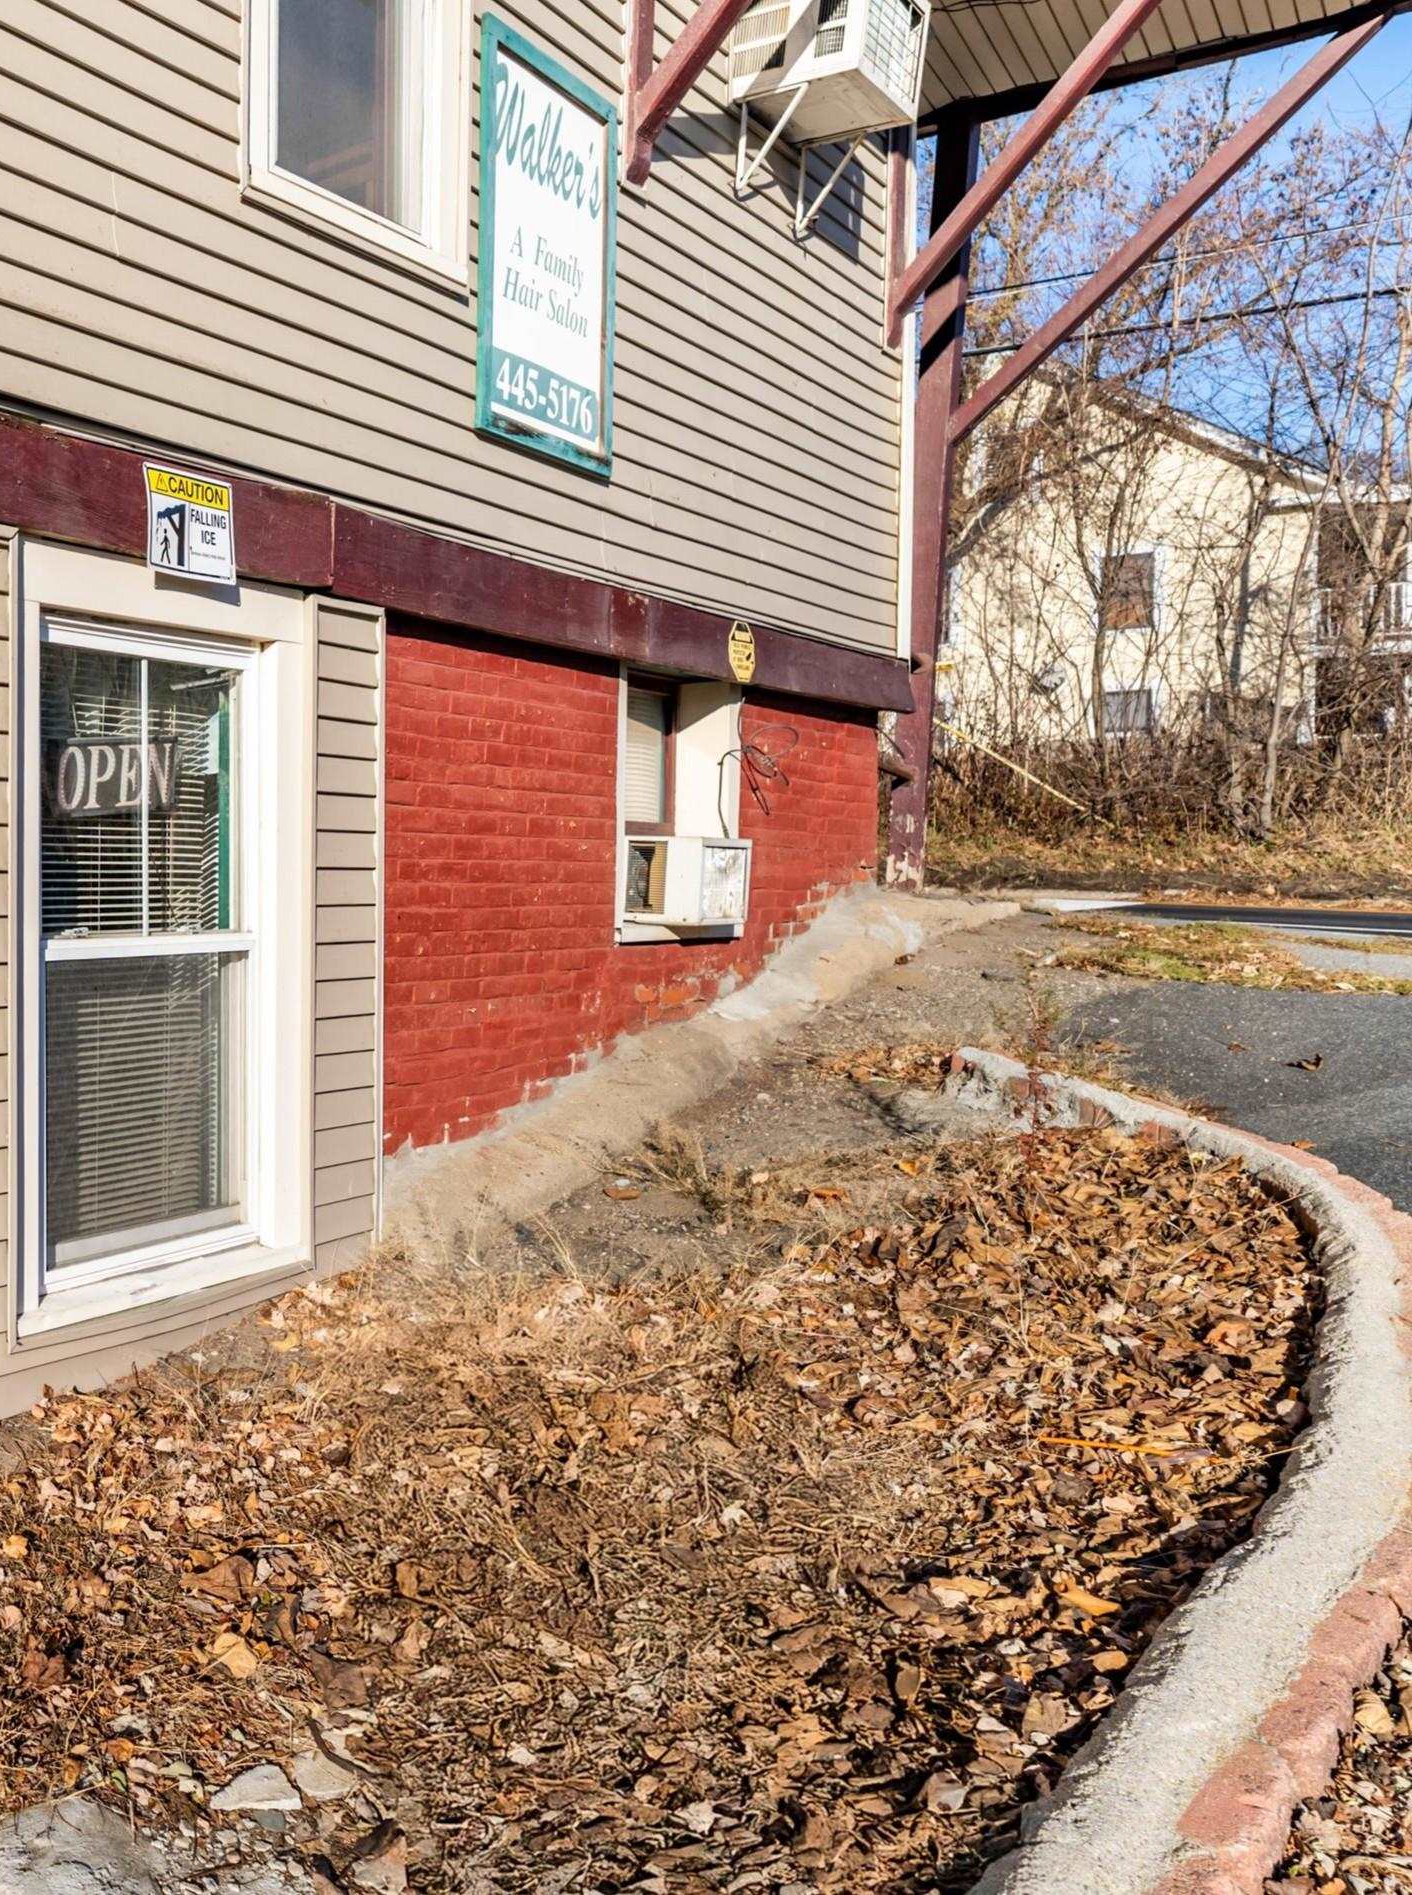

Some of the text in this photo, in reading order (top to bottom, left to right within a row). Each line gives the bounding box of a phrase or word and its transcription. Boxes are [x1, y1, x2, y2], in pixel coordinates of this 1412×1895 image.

[495, 62, 601, 219] Walker's
[509, 225, 585, 297] A Family
[502, 266, 588, 338] Hair Salon
[495, 357, 593, 434] 445-5176
[168, 477, 224, 505] CAUTION
[190, 508, 227, 529] FALLING
[201, 530, 216, 545] ICE
[57, 743, 173, 810] OPEN
